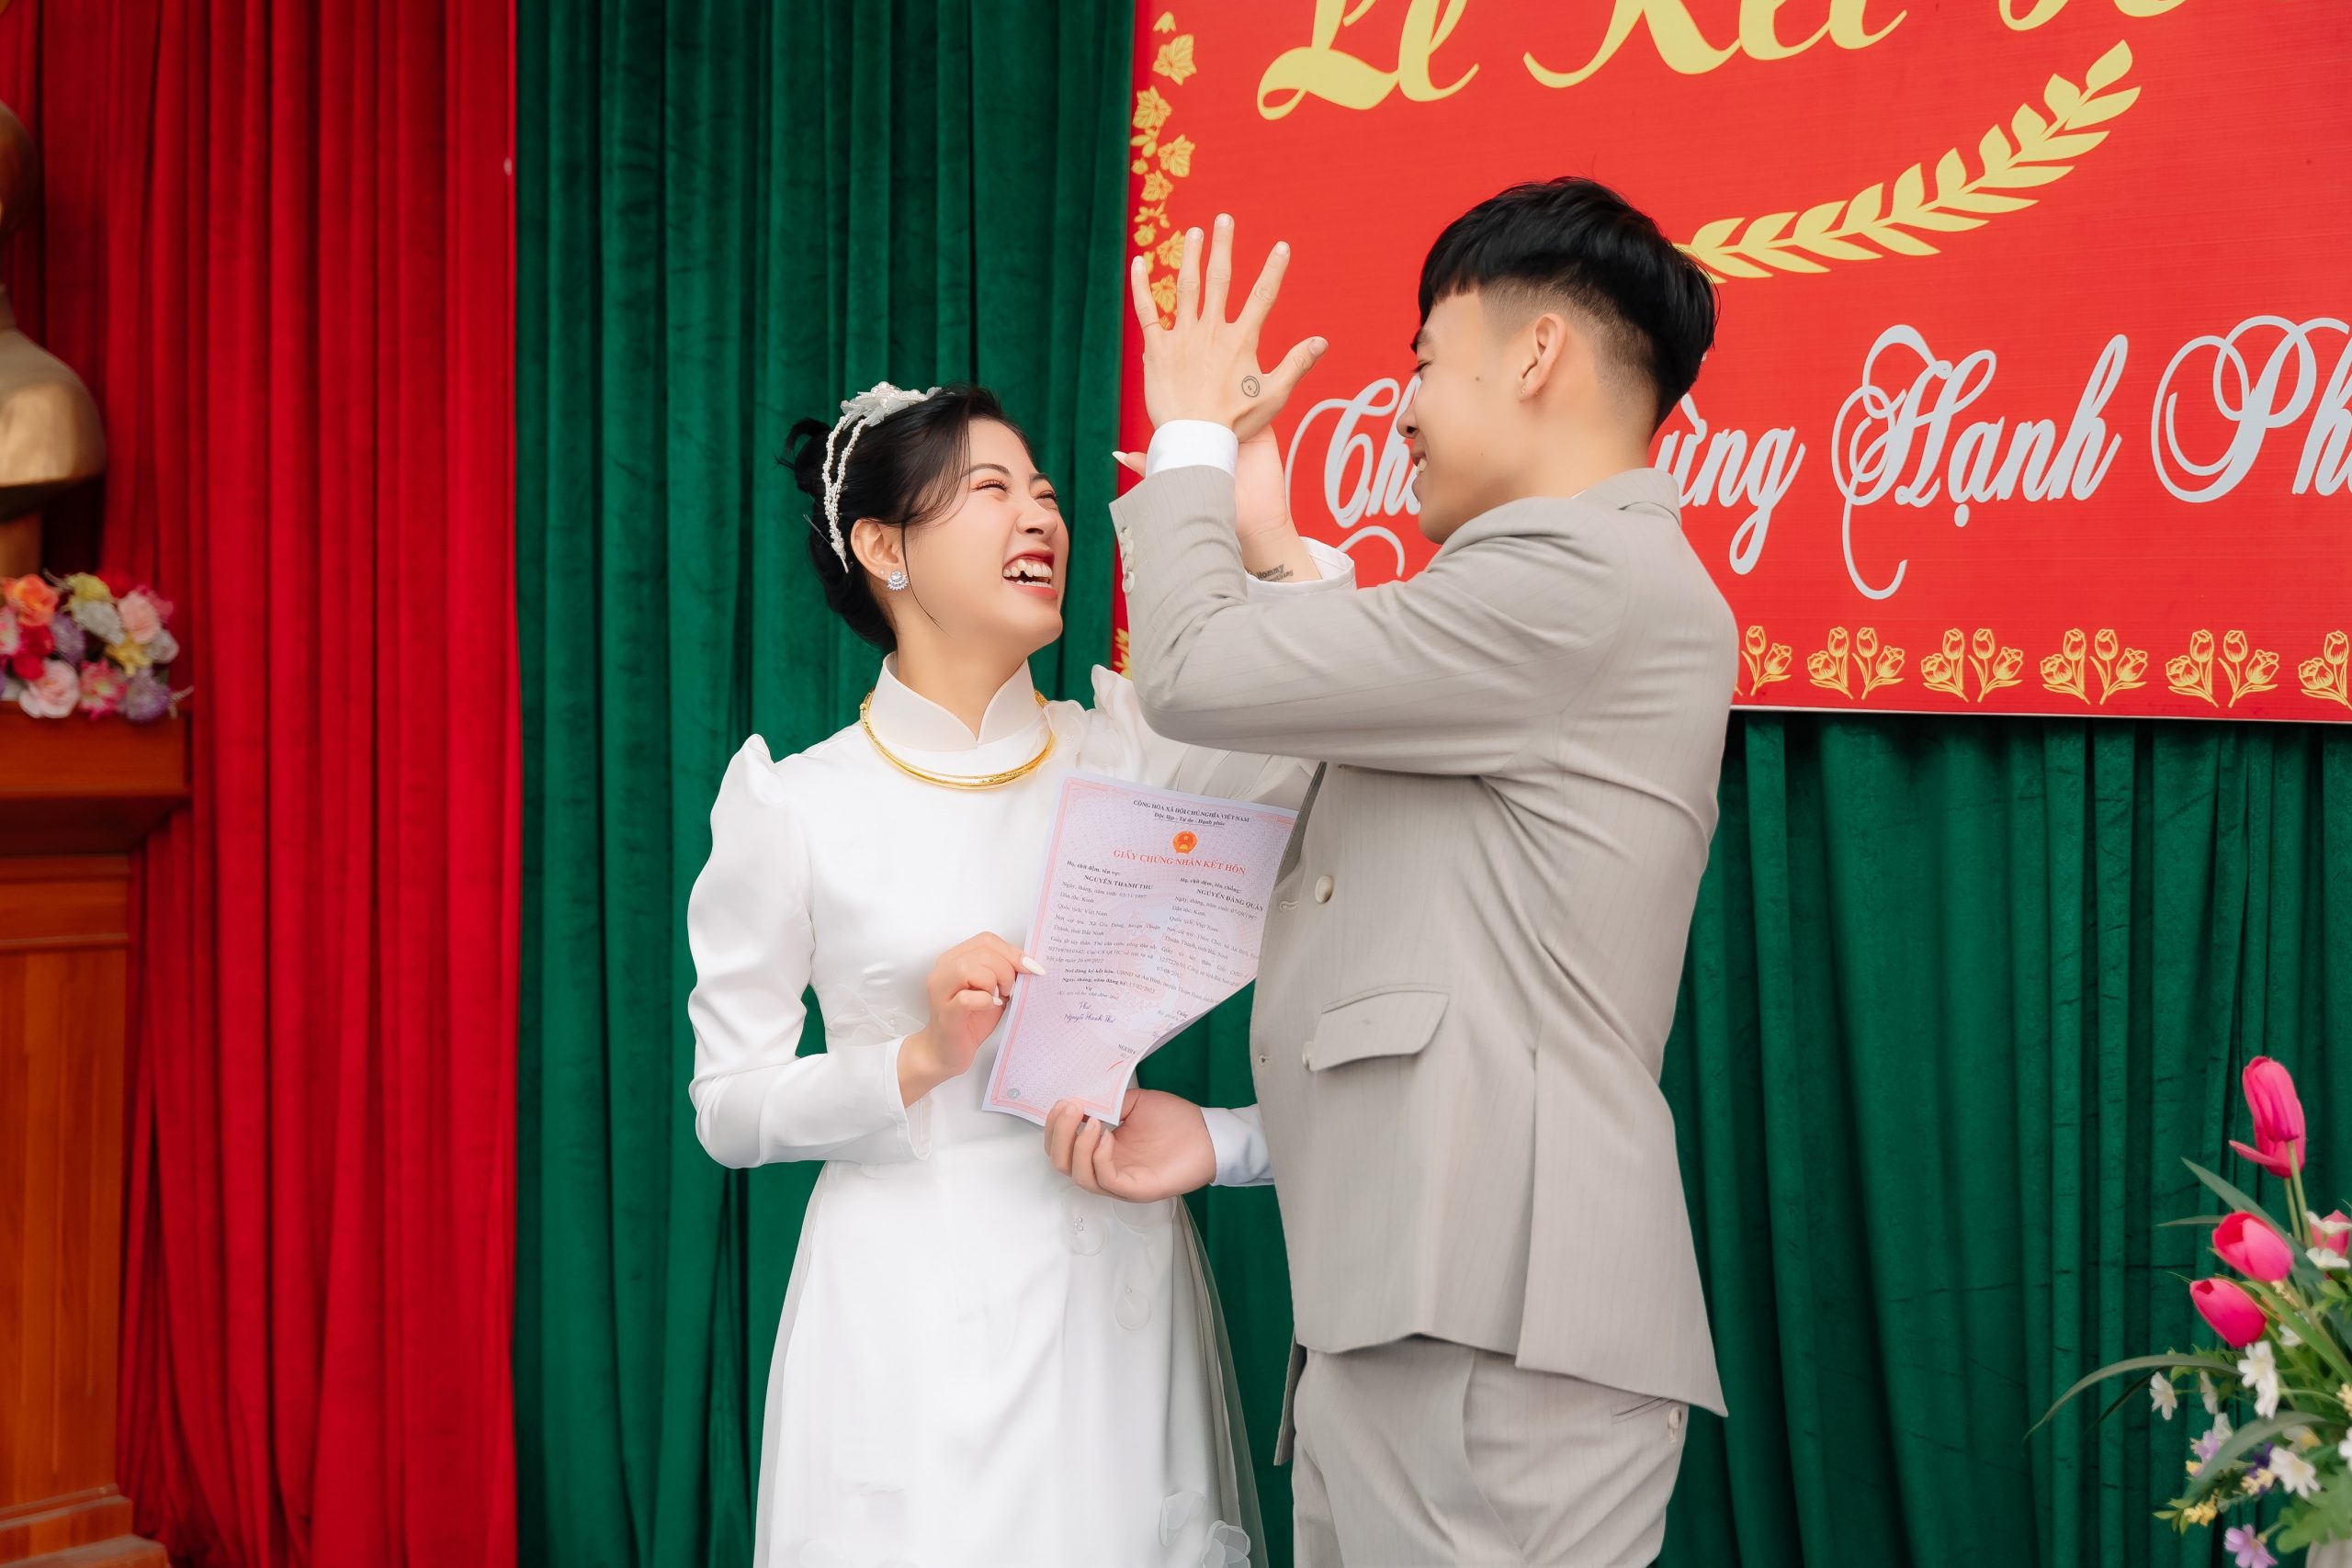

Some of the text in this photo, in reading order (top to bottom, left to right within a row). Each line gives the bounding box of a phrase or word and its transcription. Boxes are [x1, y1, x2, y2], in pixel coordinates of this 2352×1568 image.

[1285, 315, 2352, 600] Ch ừng Hạnh Ph
[1235, 815, 1250, 823] NAM
[1113, 850, 1247, 875] GIẤY CHỨNG NHẬN KẾT HÔN
[1084, 874, 1113, 886] NGUYỄN
[1196, 888, 1225, 900] NGUYỄN
